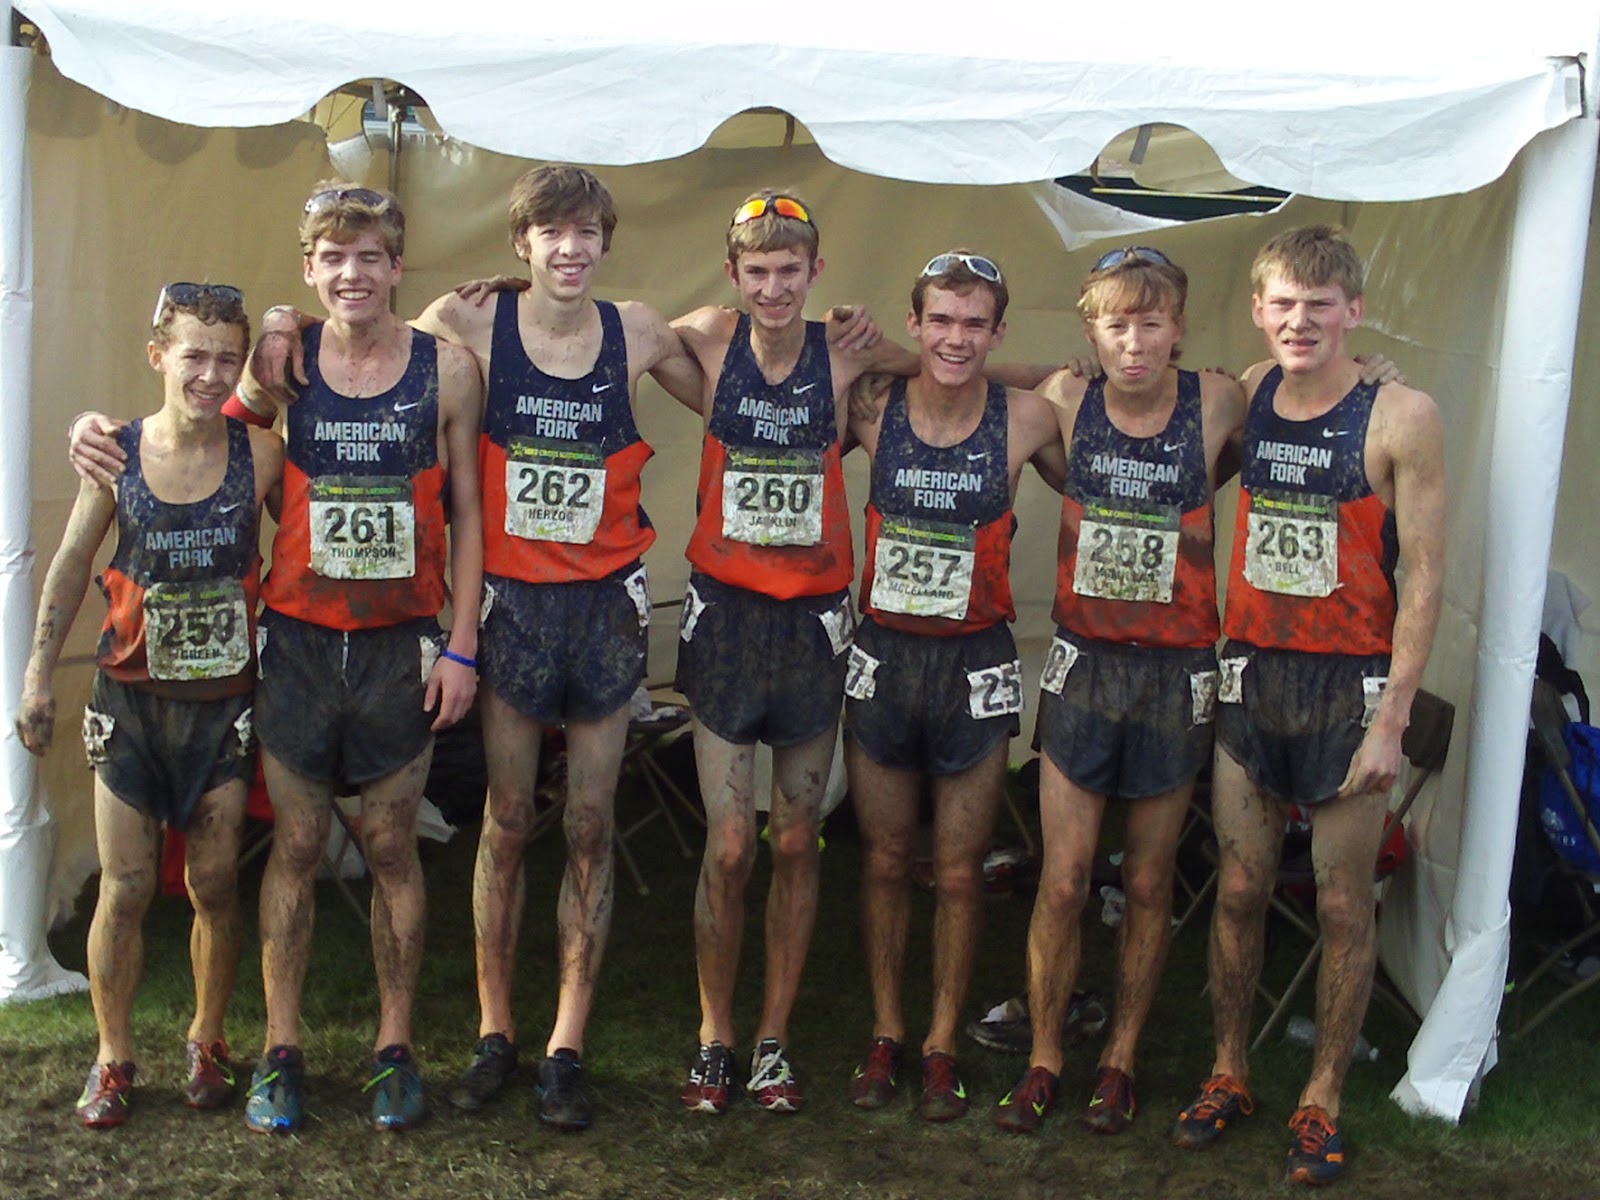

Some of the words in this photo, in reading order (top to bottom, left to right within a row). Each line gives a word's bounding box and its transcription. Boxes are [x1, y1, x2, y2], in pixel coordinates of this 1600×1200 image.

[516, 395, 602, 422] AMERICAN
[738, 397, 810, 425] AMEICAN
[314, 422, 406, 442] AMERICAN
[536, 419, 579, 440] FORK
[336, 442, 381, 461] FORK
[1256, 440, 1332, 469] AMERICAN
[895, 468, 982, 492] AMERICAN
[1091, 455, 1179, 484] AMERICAN
[1270, 462, 1307, 485] FORK
[516, 468, 591, 508] 262
[737, 477, 811, 514] 260
[914, 490, 957, 510] FORK
[1110, 477, 1153, 499] FORK
[145, 527, 236, 550] AMERICAN
[325, 506, 396, 544] 261
[332, 547, 396, 558] THOMPSON
[1090, 528, 1164, 569] 258
[1256, 521, 1324, 562] 263
[169, 550, 215, 569] FORK
[888, 546, 961, 586] 257
[1275, 562, 1301, 574] BELL
[847, 654, 868, 691] 7
[981, 664, 1021, 711] 25
